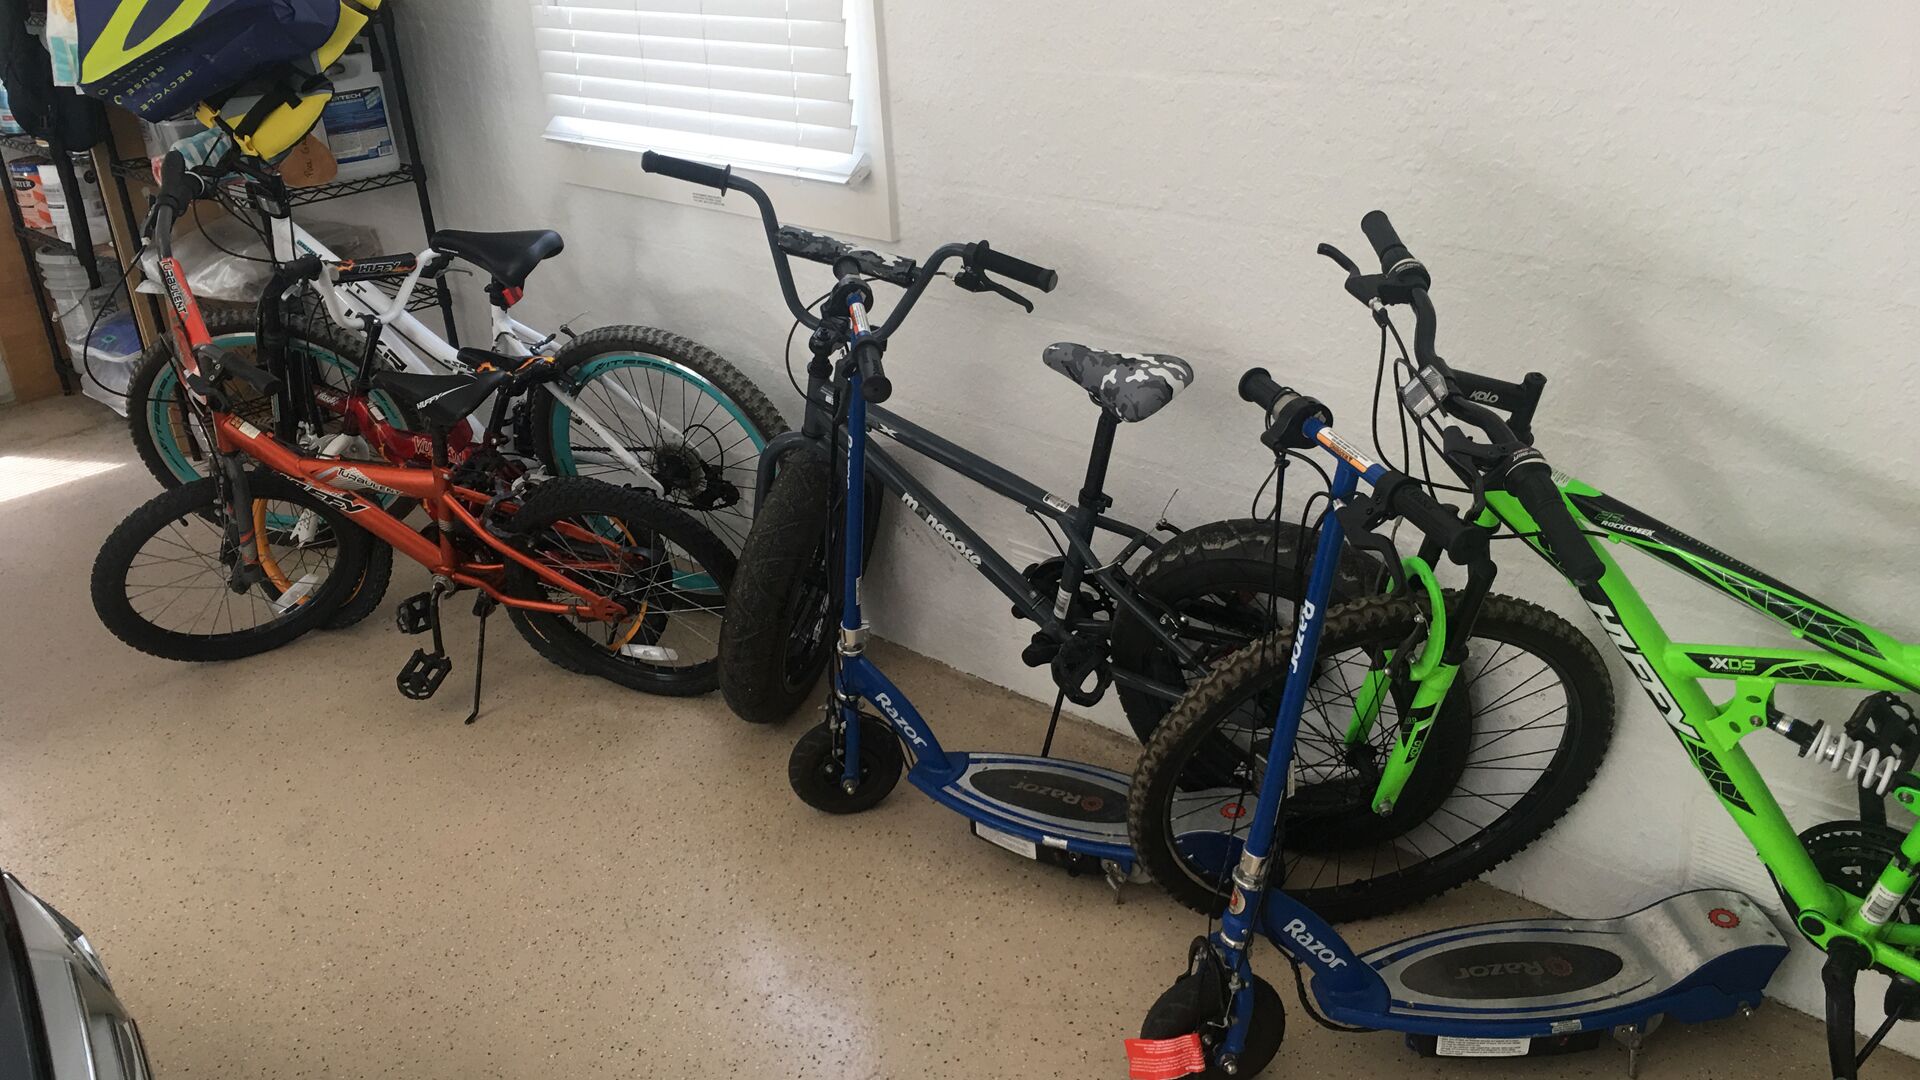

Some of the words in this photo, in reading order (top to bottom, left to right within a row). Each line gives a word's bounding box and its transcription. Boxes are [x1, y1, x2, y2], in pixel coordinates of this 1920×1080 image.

[126, 65, 165, 96] REUSE
[140, 69, 193, 111] RECYCLE
[161, 259, 188, 314] TURBULENT
[359, 261, 400, 274] HUFFY
[901, 492, 982, 569] mongoose
[1290, 598, 1315, 674] Razor
[1586, 601, 1703, 740] HUFFY
[874, 692, 928, 747] Razor
[1009, 781, 1082, 805] Razor
[1283, 918, 1347, 969] Razor
[1455, 961, 1545, 979] Razor
